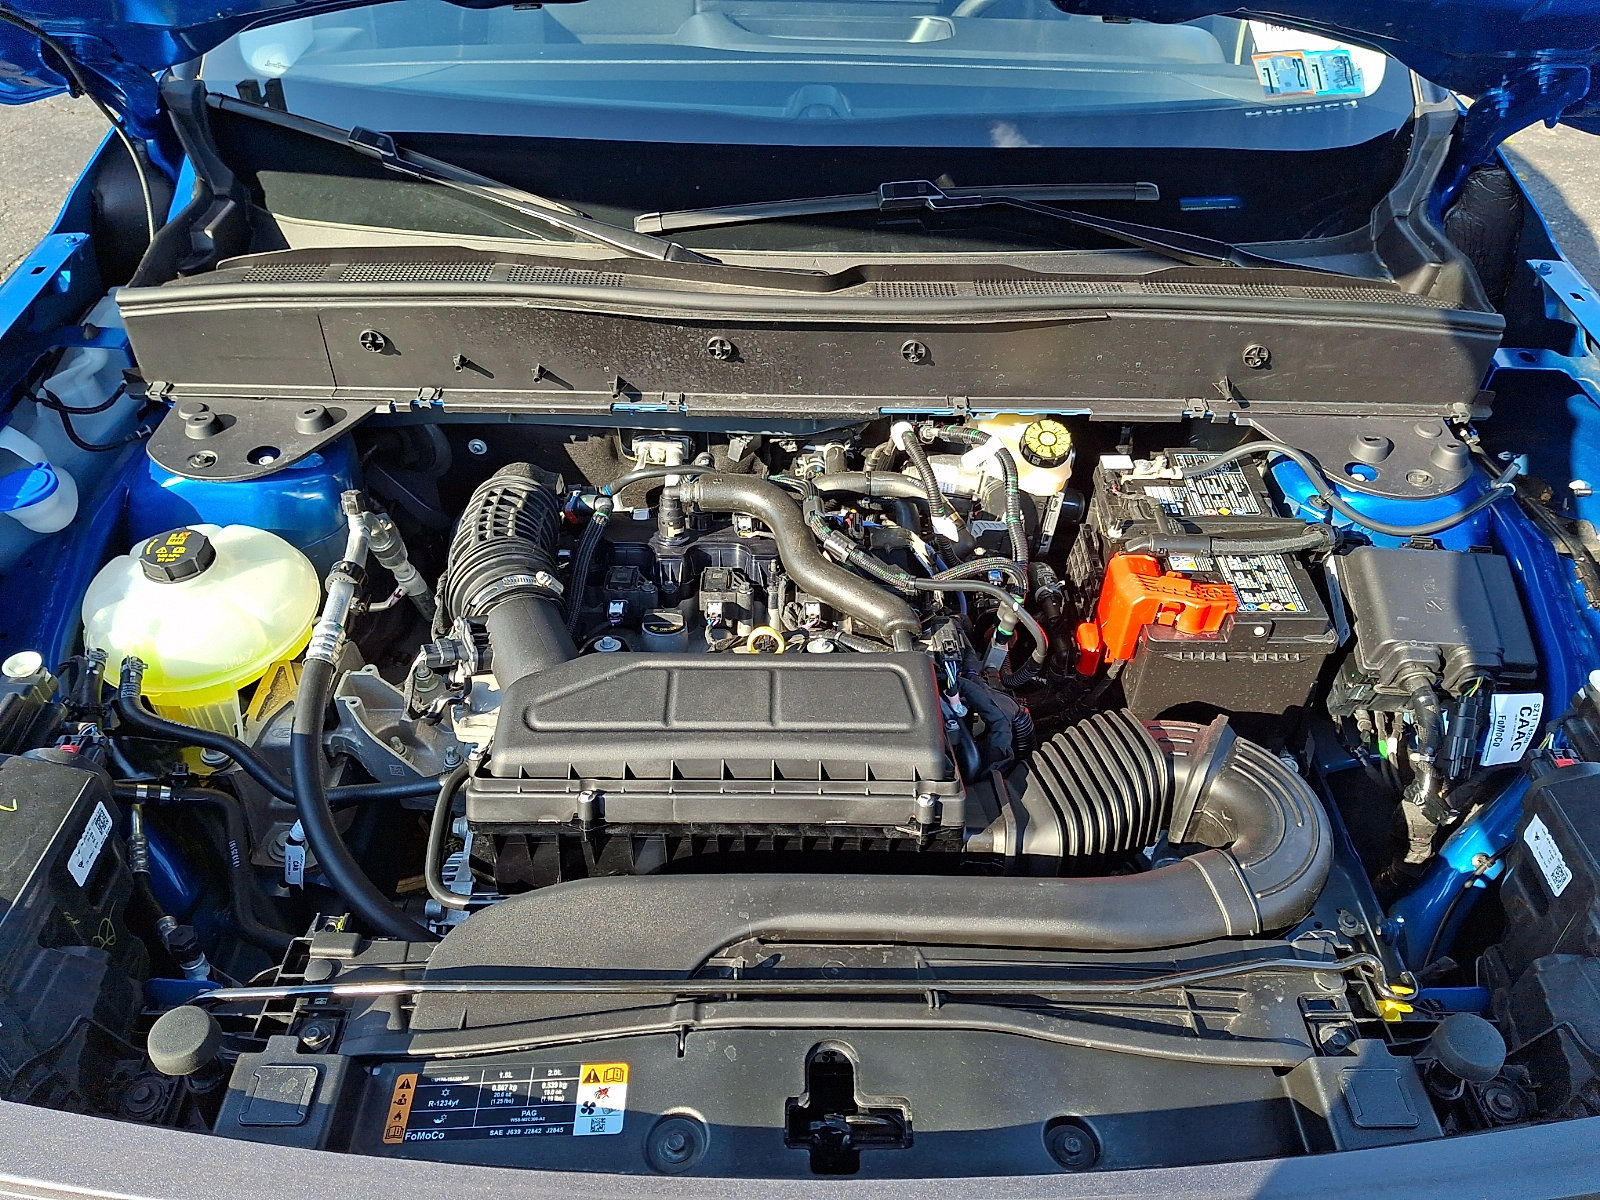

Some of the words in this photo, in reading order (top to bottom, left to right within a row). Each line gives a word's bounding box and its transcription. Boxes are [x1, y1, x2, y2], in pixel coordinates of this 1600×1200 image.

[1492, 715, 1507, 748] FoMoCo
[1510, 706, 1533, 752] CAAC
[509, 1084, 518, 1092] kg
[558, 1082, 568, 1090] kg
[428, 1099, 460, 1108] R-1234yf
[404, 1131, 445, 1141] FoMoCo
